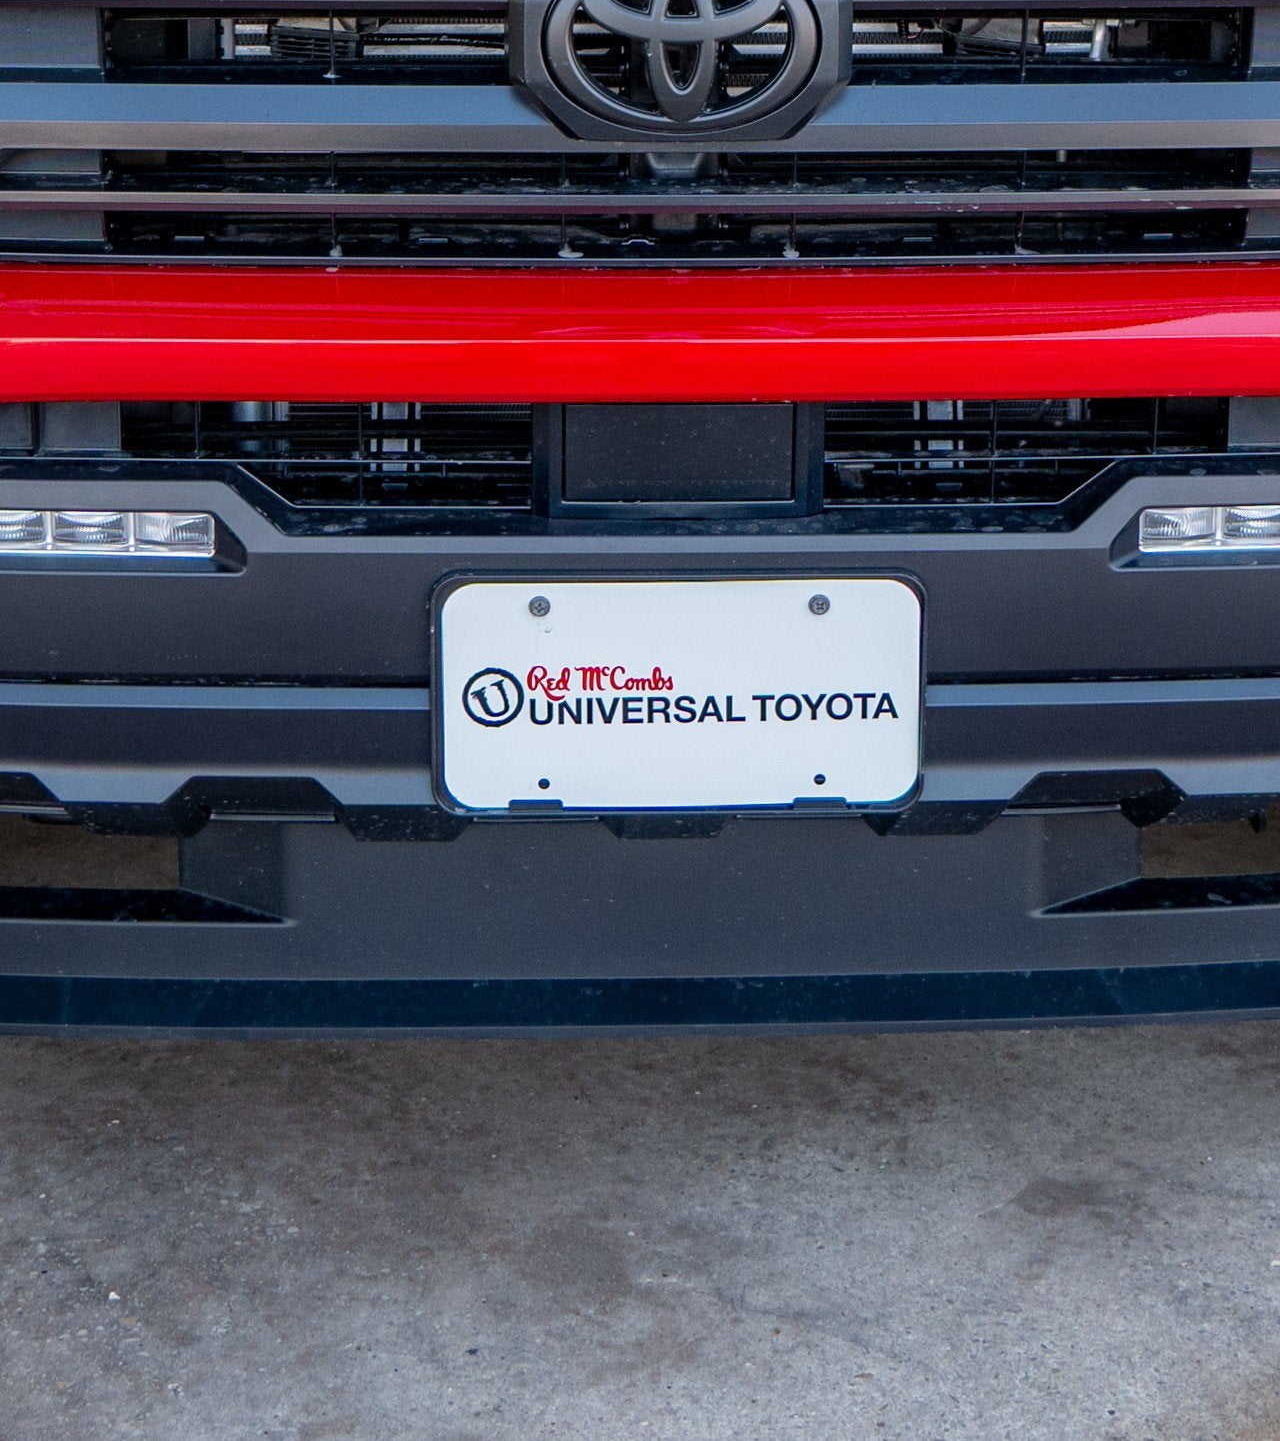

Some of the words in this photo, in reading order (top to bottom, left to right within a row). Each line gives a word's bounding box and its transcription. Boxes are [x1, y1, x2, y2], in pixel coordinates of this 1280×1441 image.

[526, 665, 571, 701] Red
[575, 665, 673, 691] McCombs
[529, 695, 746, 726] UNIVERSAL
[752, 692, 899, 722] TOYOTA
